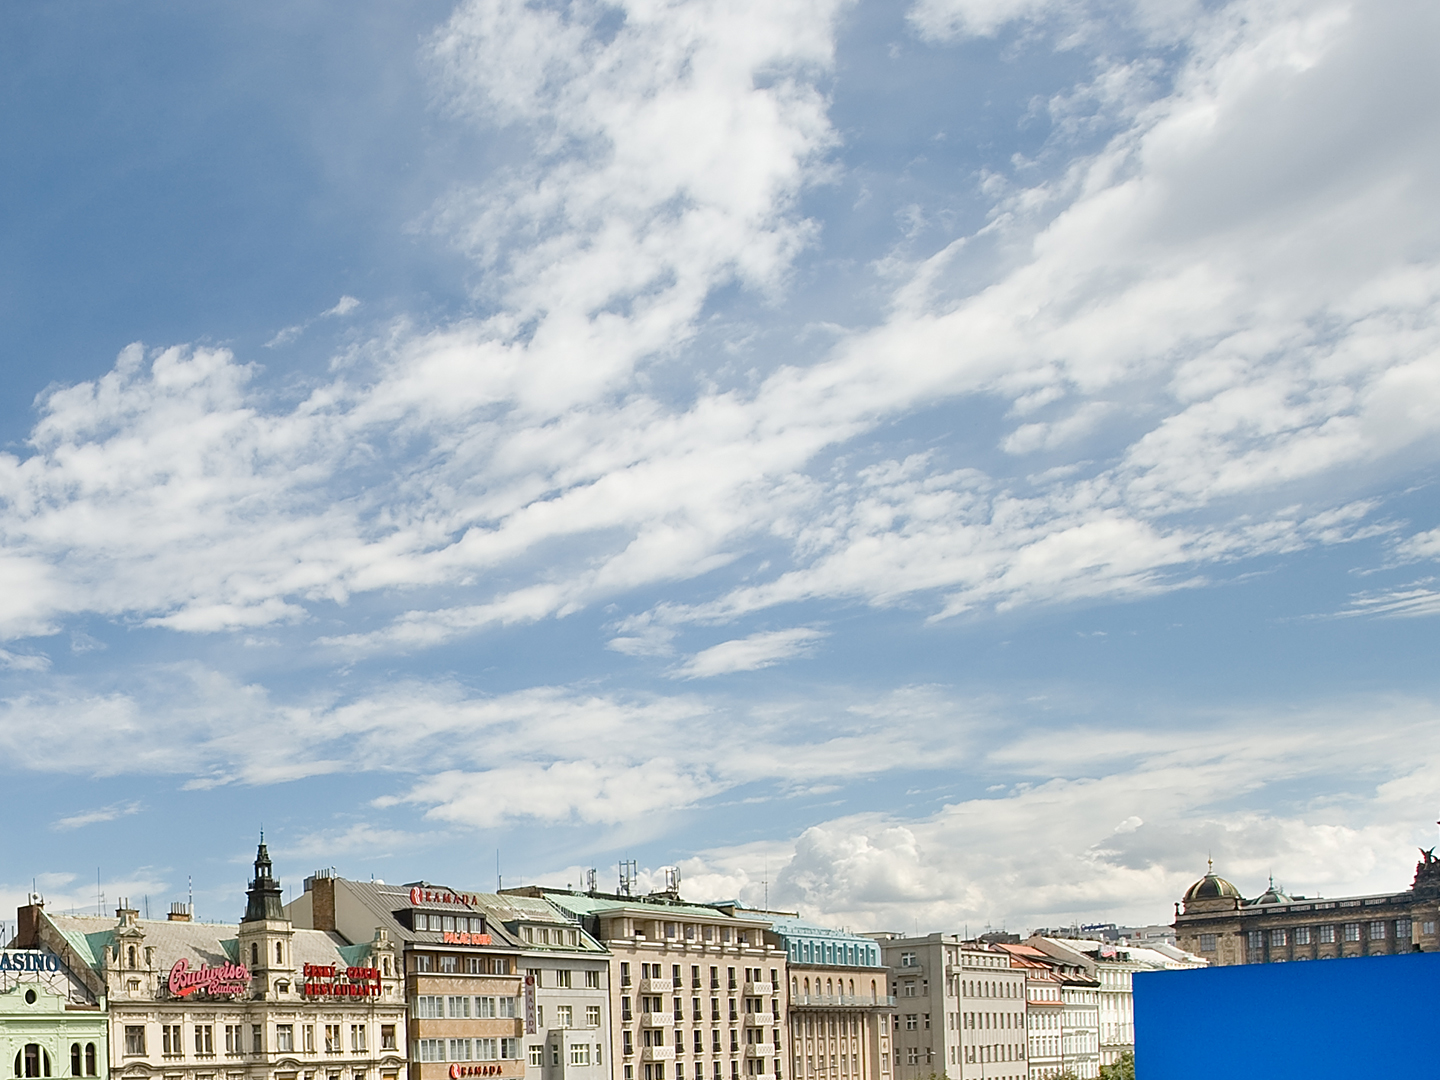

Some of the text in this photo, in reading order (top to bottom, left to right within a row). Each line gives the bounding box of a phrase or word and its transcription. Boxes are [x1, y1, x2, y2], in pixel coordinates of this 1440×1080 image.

[425, 891, 478, 906] RAMADA
[169, 957, 253, 995] Budweiser
[208, 979, 244, 995] Budvar
[304, 983, 376, 997] RESTAURANT
[527, 990, 535, 1034] RAMADA
[460, 1065, 503, 1078] RAMADA
